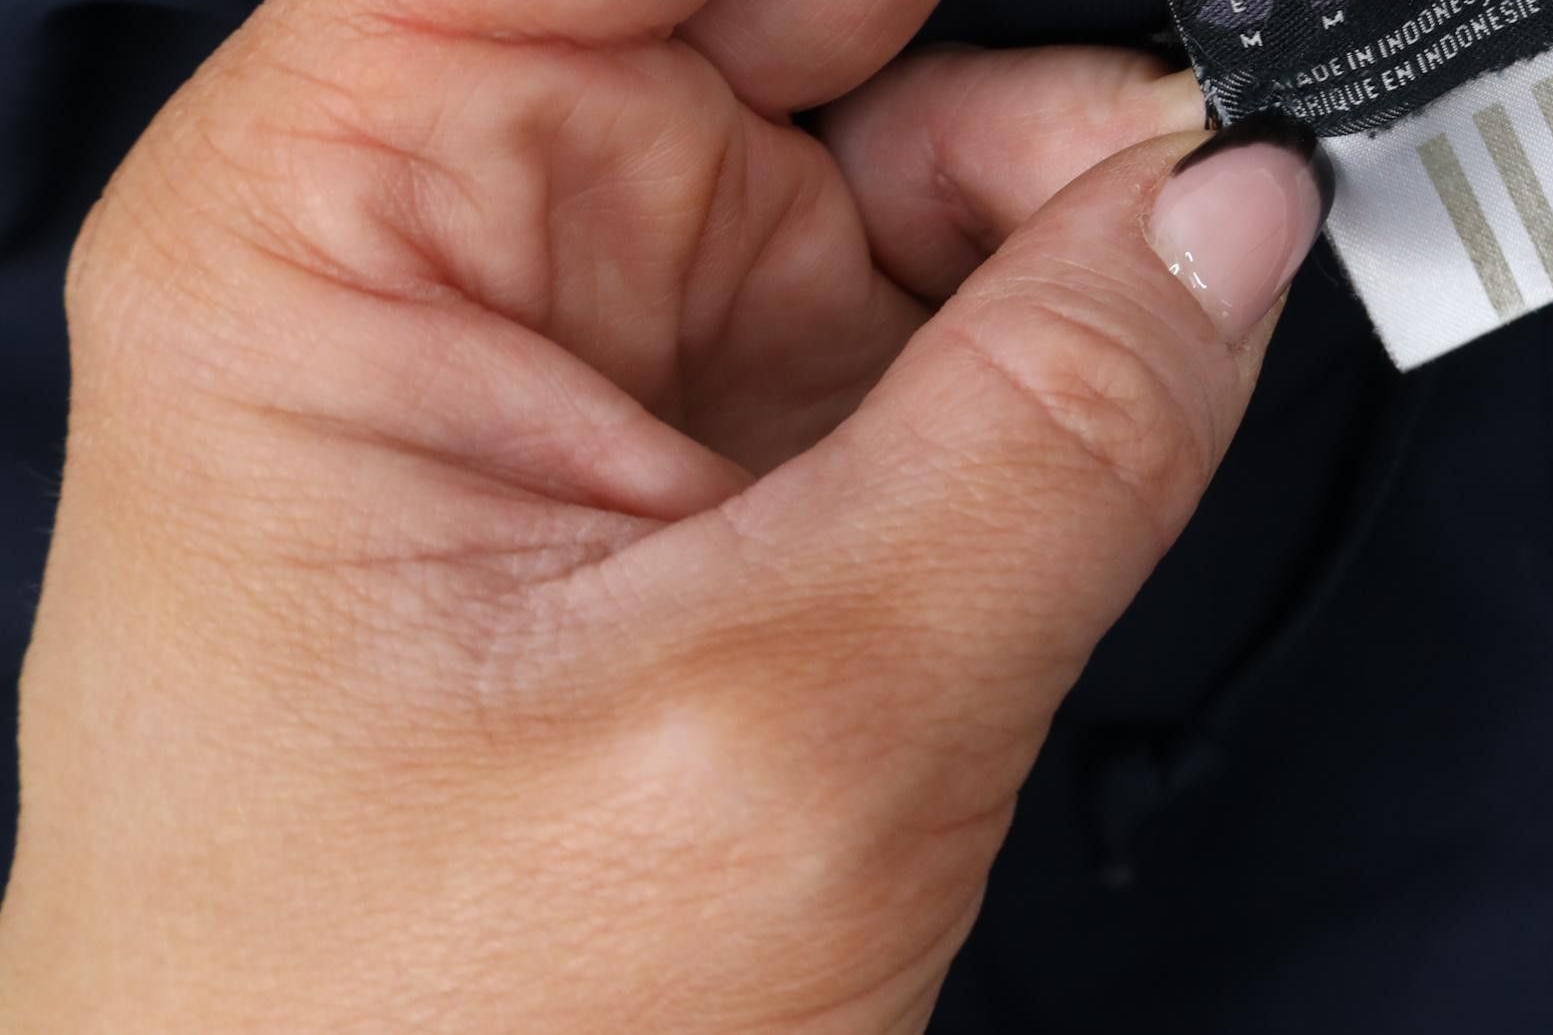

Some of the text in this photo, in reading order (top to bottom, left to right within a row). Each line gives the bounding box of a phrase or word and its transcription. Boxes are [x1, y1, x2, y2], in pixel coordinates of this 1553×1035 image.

[1240, 30, 1264, 49] M
[1321, 9, 1345, 30] M
[1296, 57, 1345, 88] ADE
[1346, 45, 1377, 72] IN
[1380, 60, 1417, 93] EN
